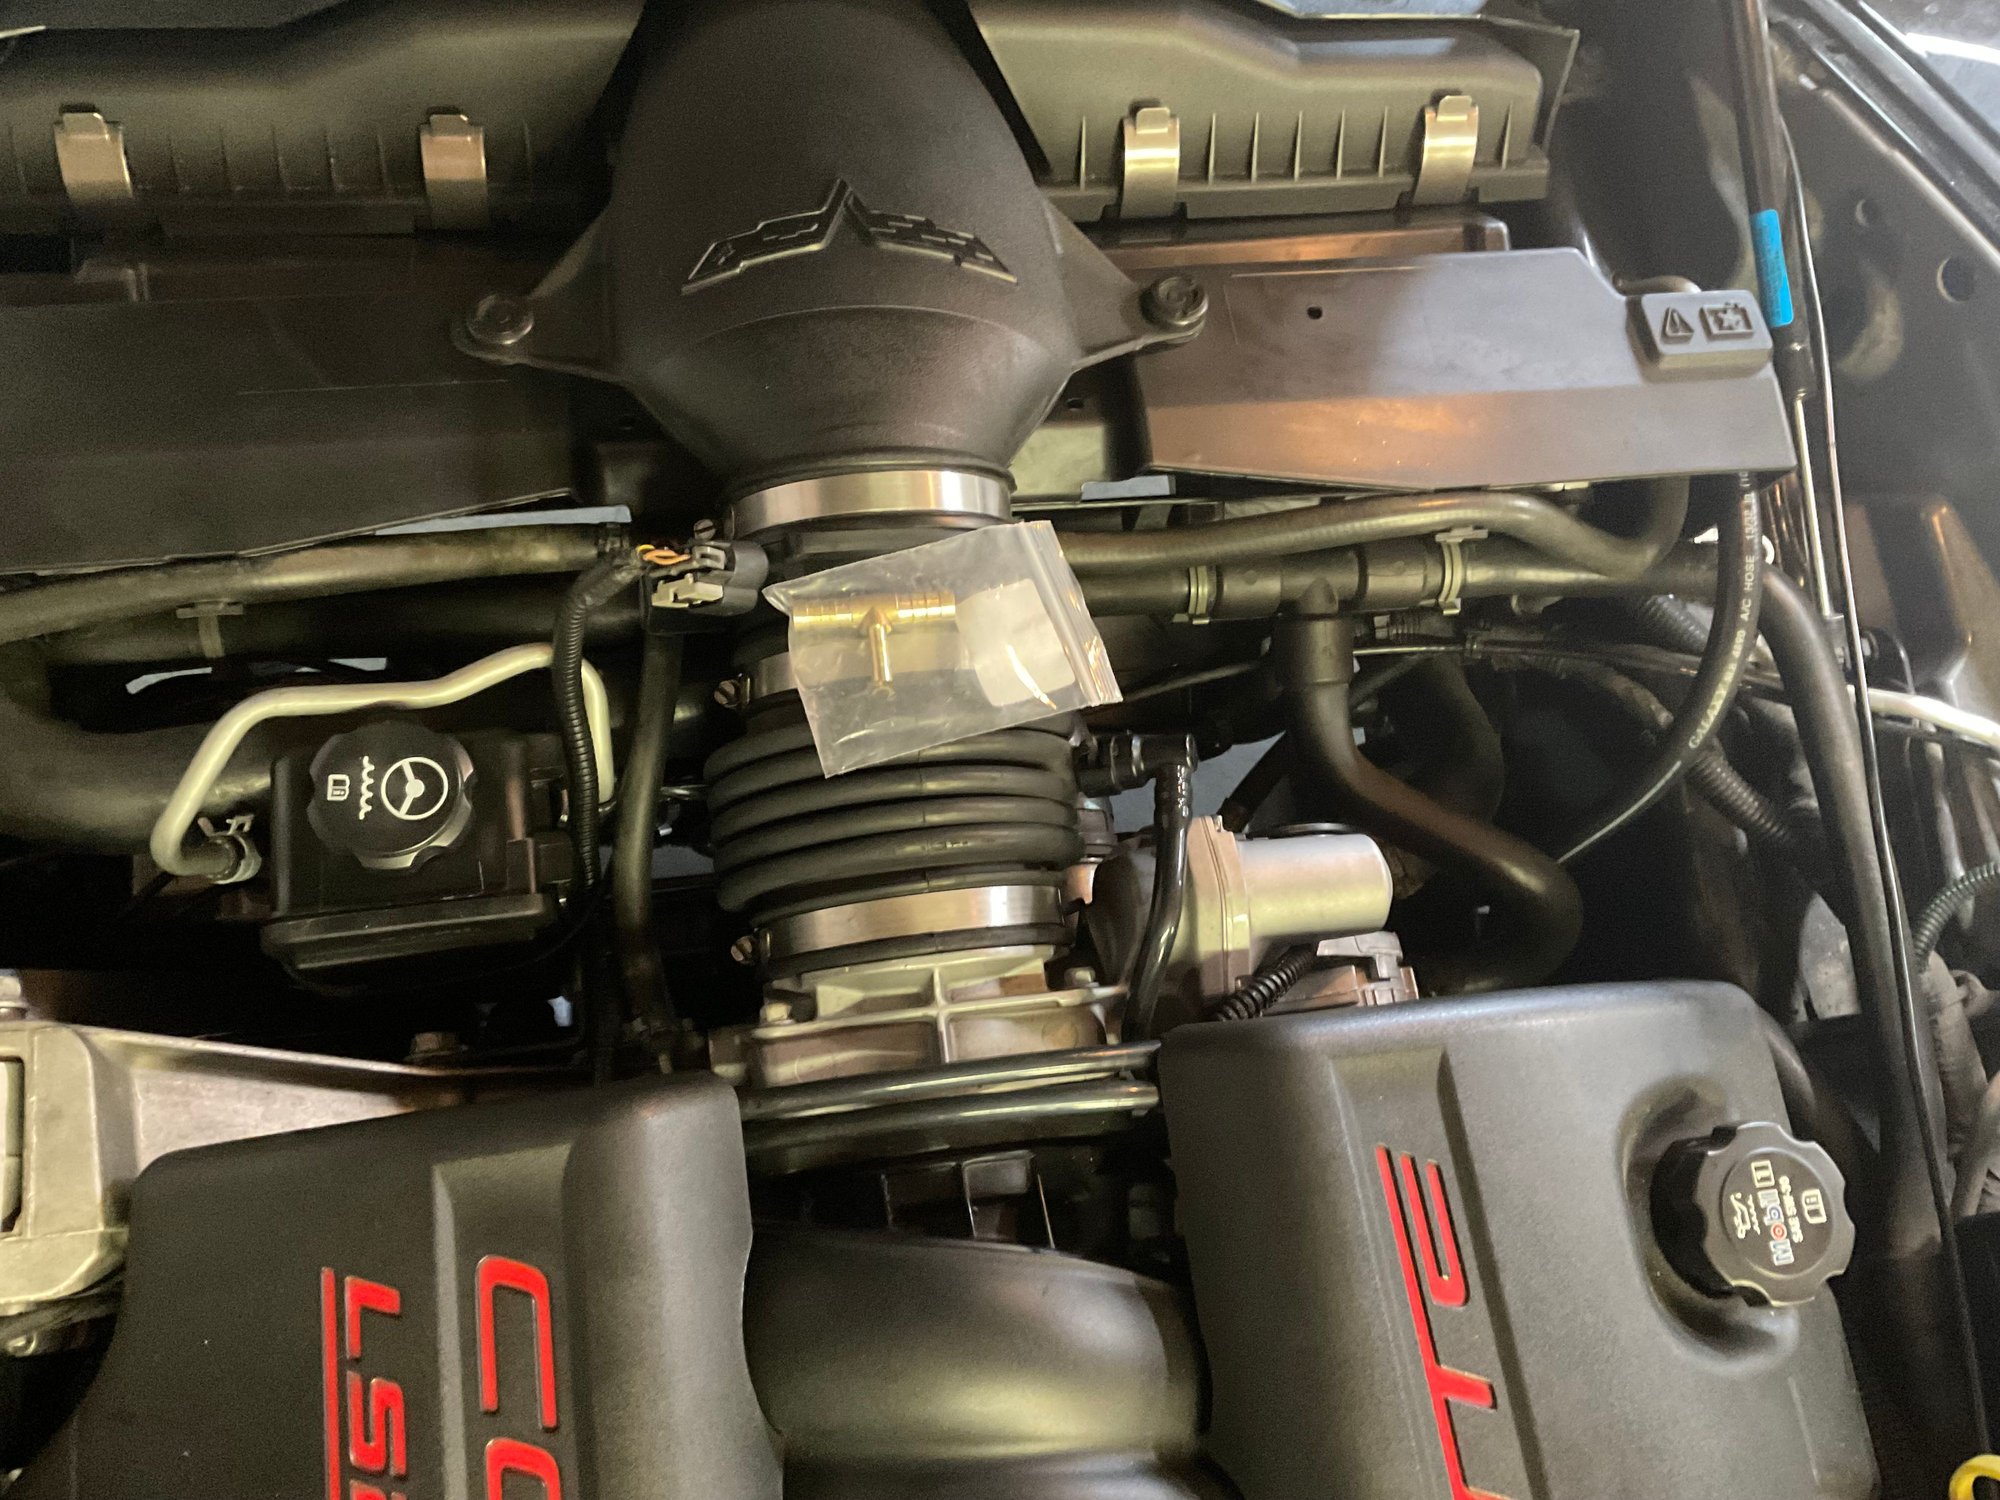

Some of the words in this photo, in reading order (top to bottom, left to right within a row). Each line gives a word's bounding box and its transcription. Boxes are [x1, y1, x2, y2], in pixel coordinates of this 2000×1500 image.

[1744, 555, 1755, 591] HOSE
[1740, 598, 1751, 621] A/C
[1757, 1189, 1795, 1266] Mobil
